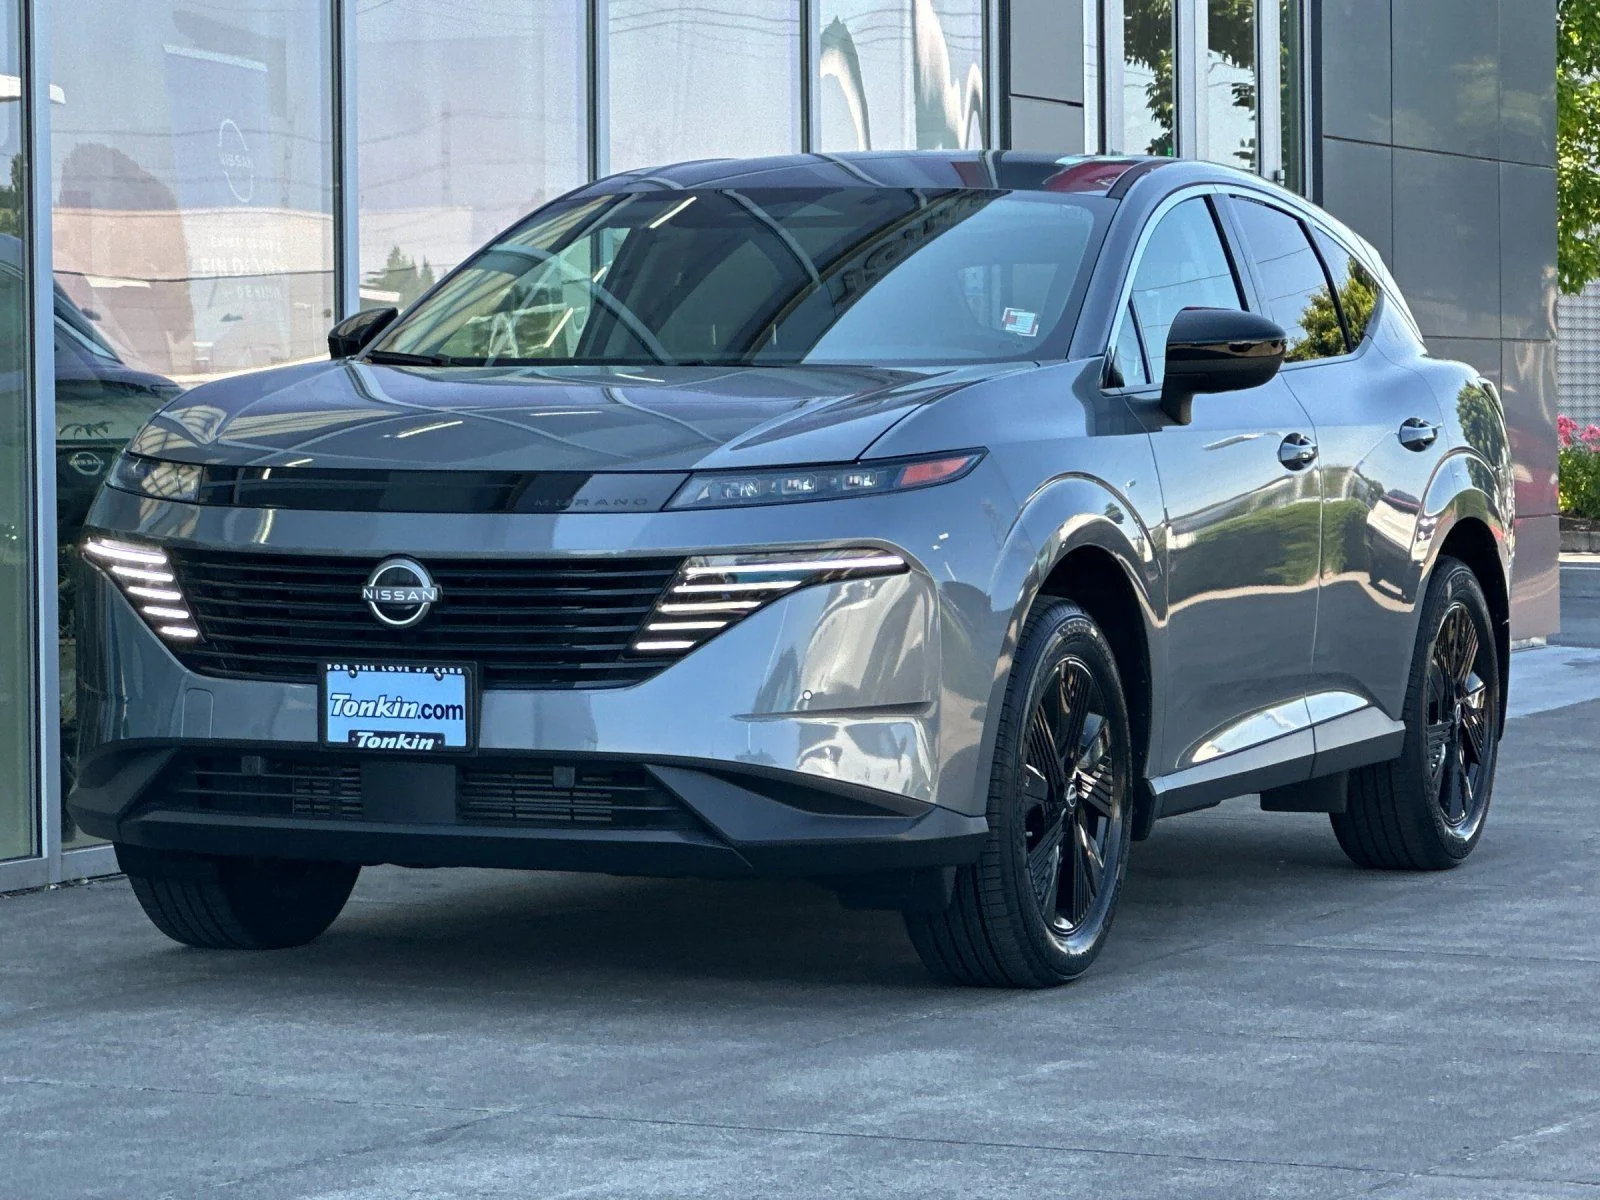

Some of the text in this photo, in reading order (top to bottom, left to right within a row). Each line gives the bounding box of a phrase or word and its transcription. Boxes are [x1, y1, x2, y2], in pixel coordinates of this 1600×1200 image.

[534, 497, 648, 508] MURANO
[363, 588, 435, 601] NISSAN
[326, 663, 348, 671] FOR
[433, 666, 463, 674] CARS
[331, 692, 464, 720] Tonkin.com
[356, 731, 435, 750] Tonkin
